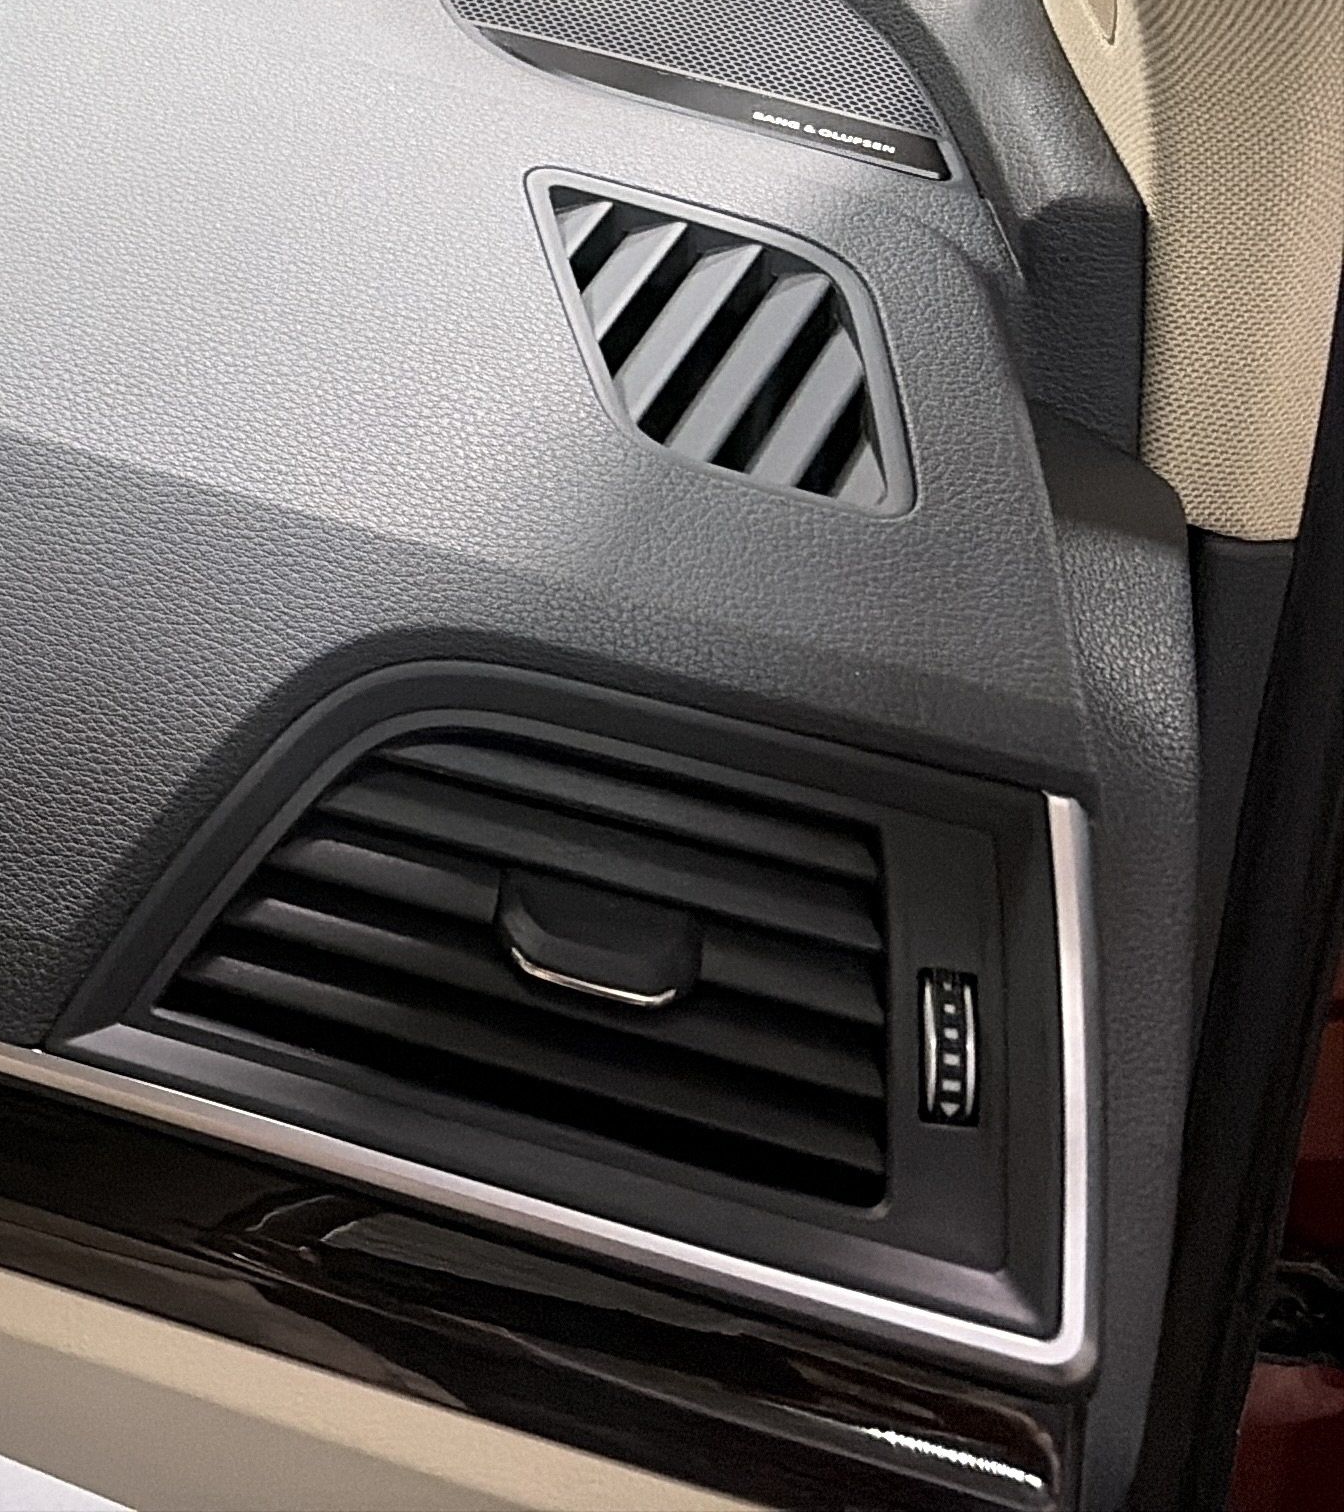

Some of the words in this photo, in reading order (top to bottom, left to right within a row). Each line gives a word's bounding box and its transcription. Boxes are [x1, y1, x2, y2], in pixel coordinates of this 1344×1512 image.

[752, 111, 800, 130] BANG
[803, 124, 816, 134] &
[818, 127, 895, 154] OLUFSEN
